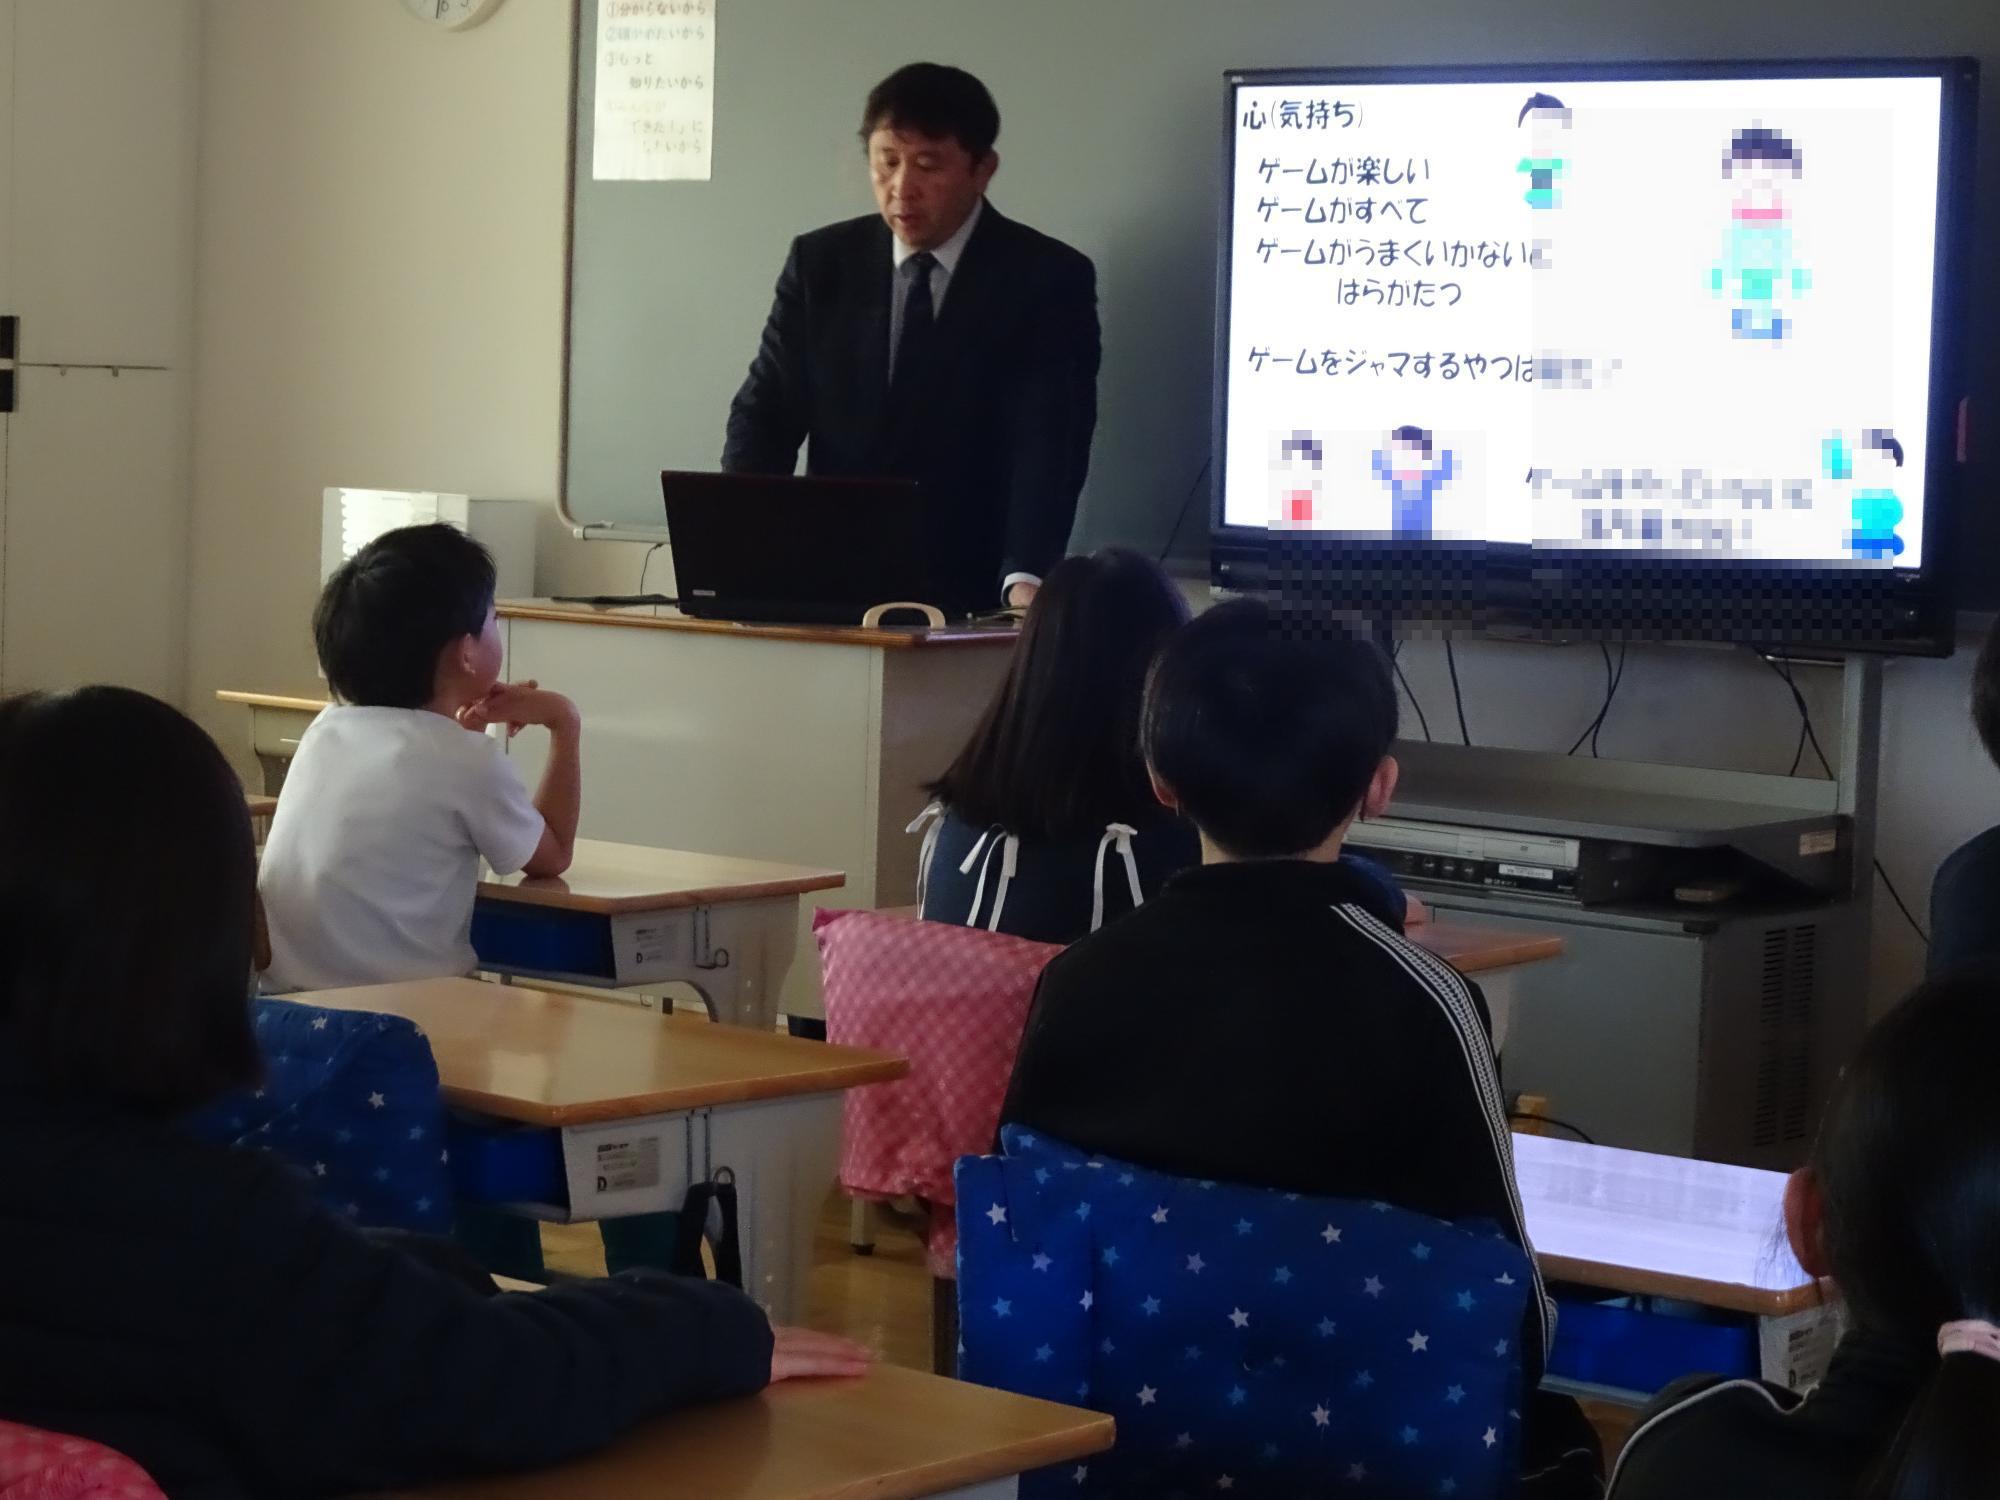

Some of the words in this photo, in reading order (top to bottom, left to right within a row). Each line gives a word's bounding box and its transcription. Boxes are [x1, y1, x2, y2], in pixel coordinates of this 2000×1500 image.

[1243, 100, 1363, 130] 心(気持ち)
[1258, 156, 1430, 186] ゲームが楽しい
[1257, 196, 1429, 224] ゲームがすべて
[1338, 278, 1462, 307] はらがたつ
[598, 1175, 607, 1192] D
